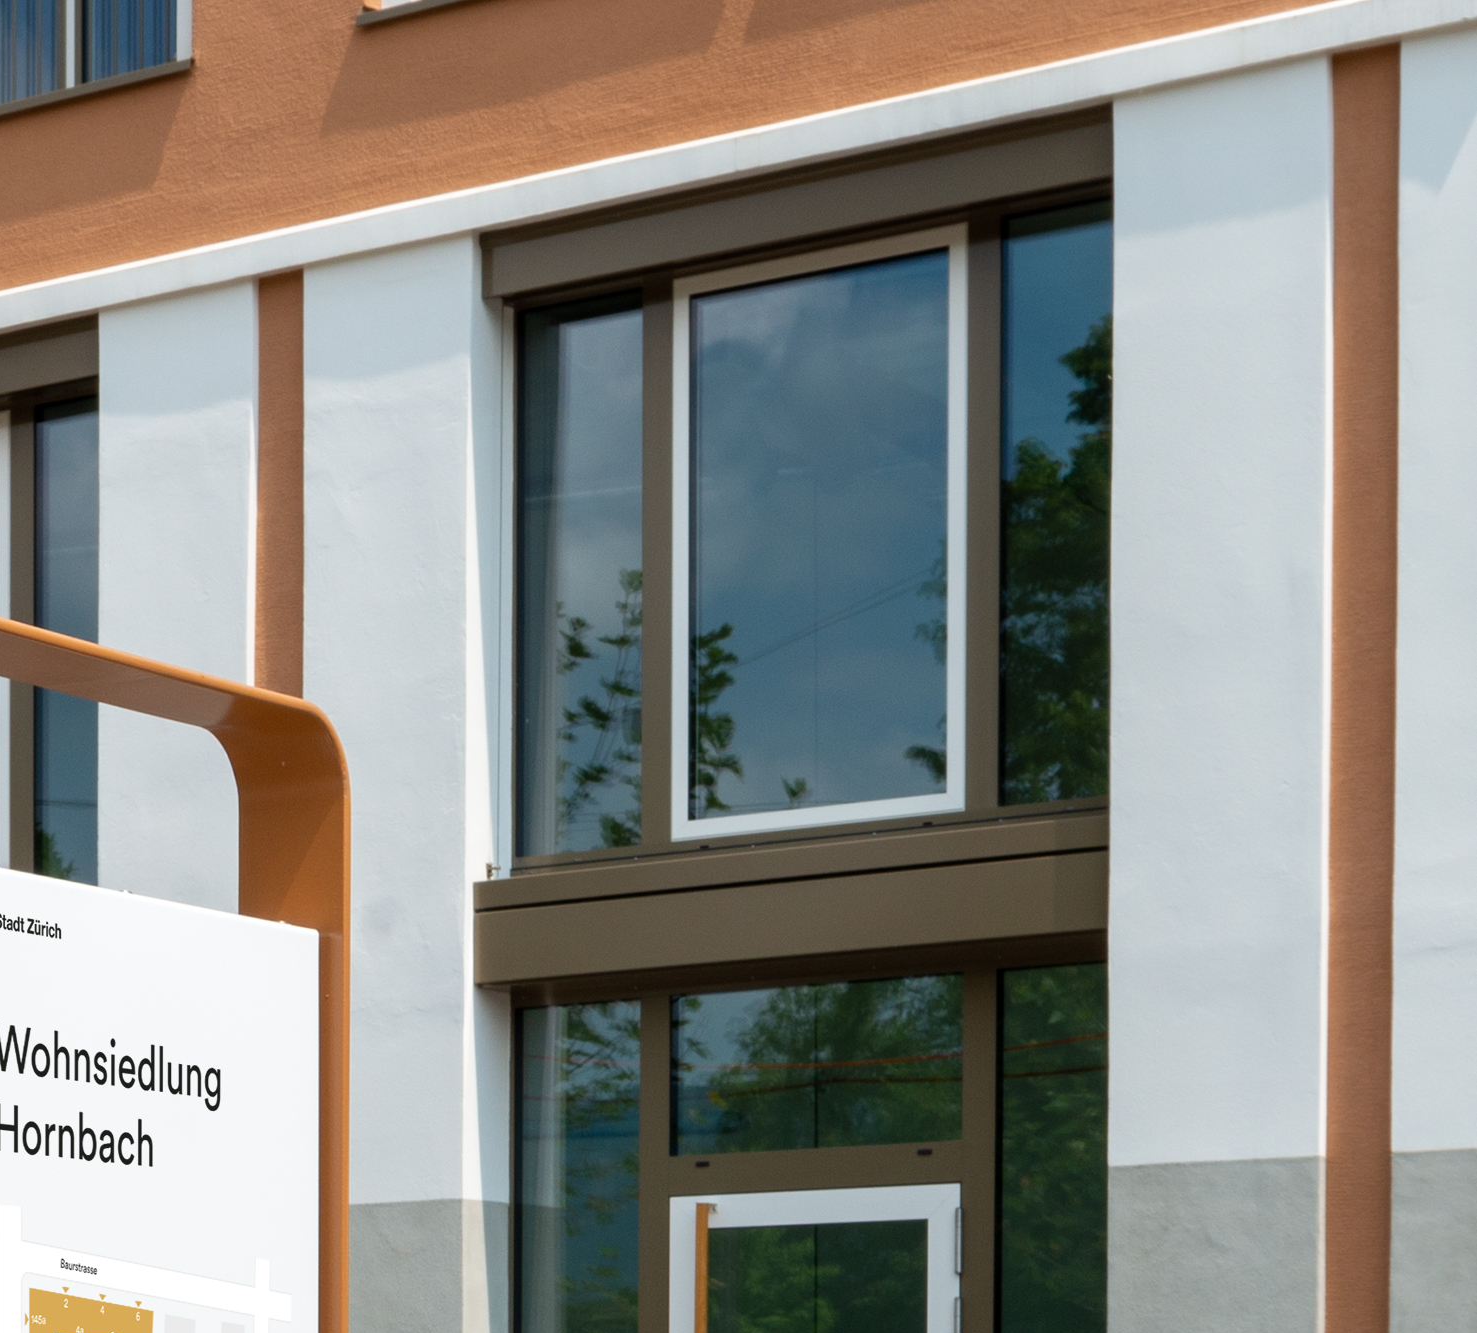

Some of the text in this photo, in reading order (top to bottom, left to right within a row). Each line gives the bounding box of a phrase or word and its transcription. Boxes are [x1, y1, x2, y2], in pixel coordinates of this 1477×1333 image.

[27, 918, 61, 939] Zürich
[60, 1258, 98, 1275] Baurstrasse
[64, 1299, 68, 1308] 2
[100, 1306, 104, 1314] 4
[31, 1315, 46, 1324] 145a
[136, 1312, 140, 1321] 6
